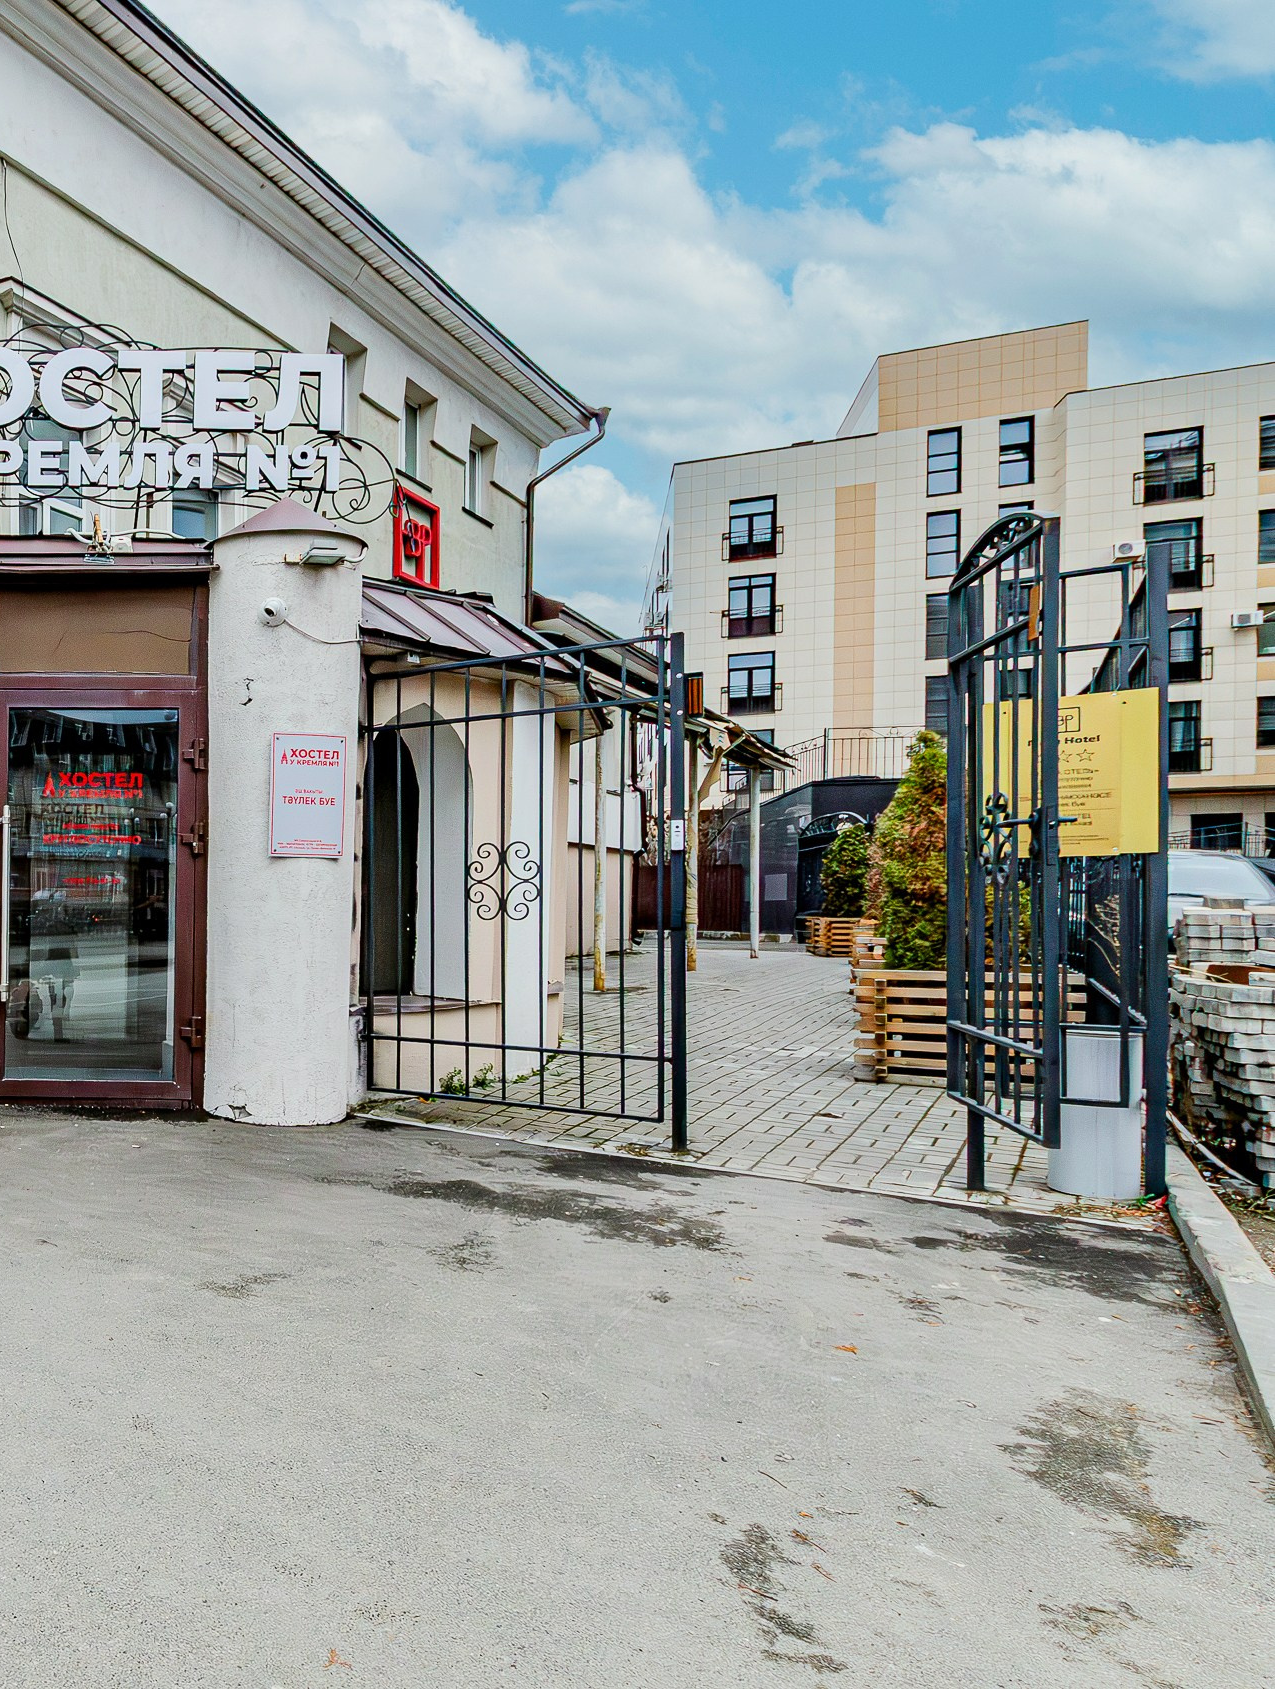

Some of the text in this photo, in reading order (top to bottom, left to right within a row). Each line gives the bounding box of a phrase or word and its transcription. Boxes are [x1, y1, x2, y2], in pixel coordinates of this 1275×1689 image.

[245, 443, 342, 493] №1
[1064, 734, 1101, 744] Hotel
[290, 748, 340, 760] ХОСТЕЛ
[59, 771, 143, 788] ХОСТЕЛ
[319, 797, 336, 806] БУЕ
